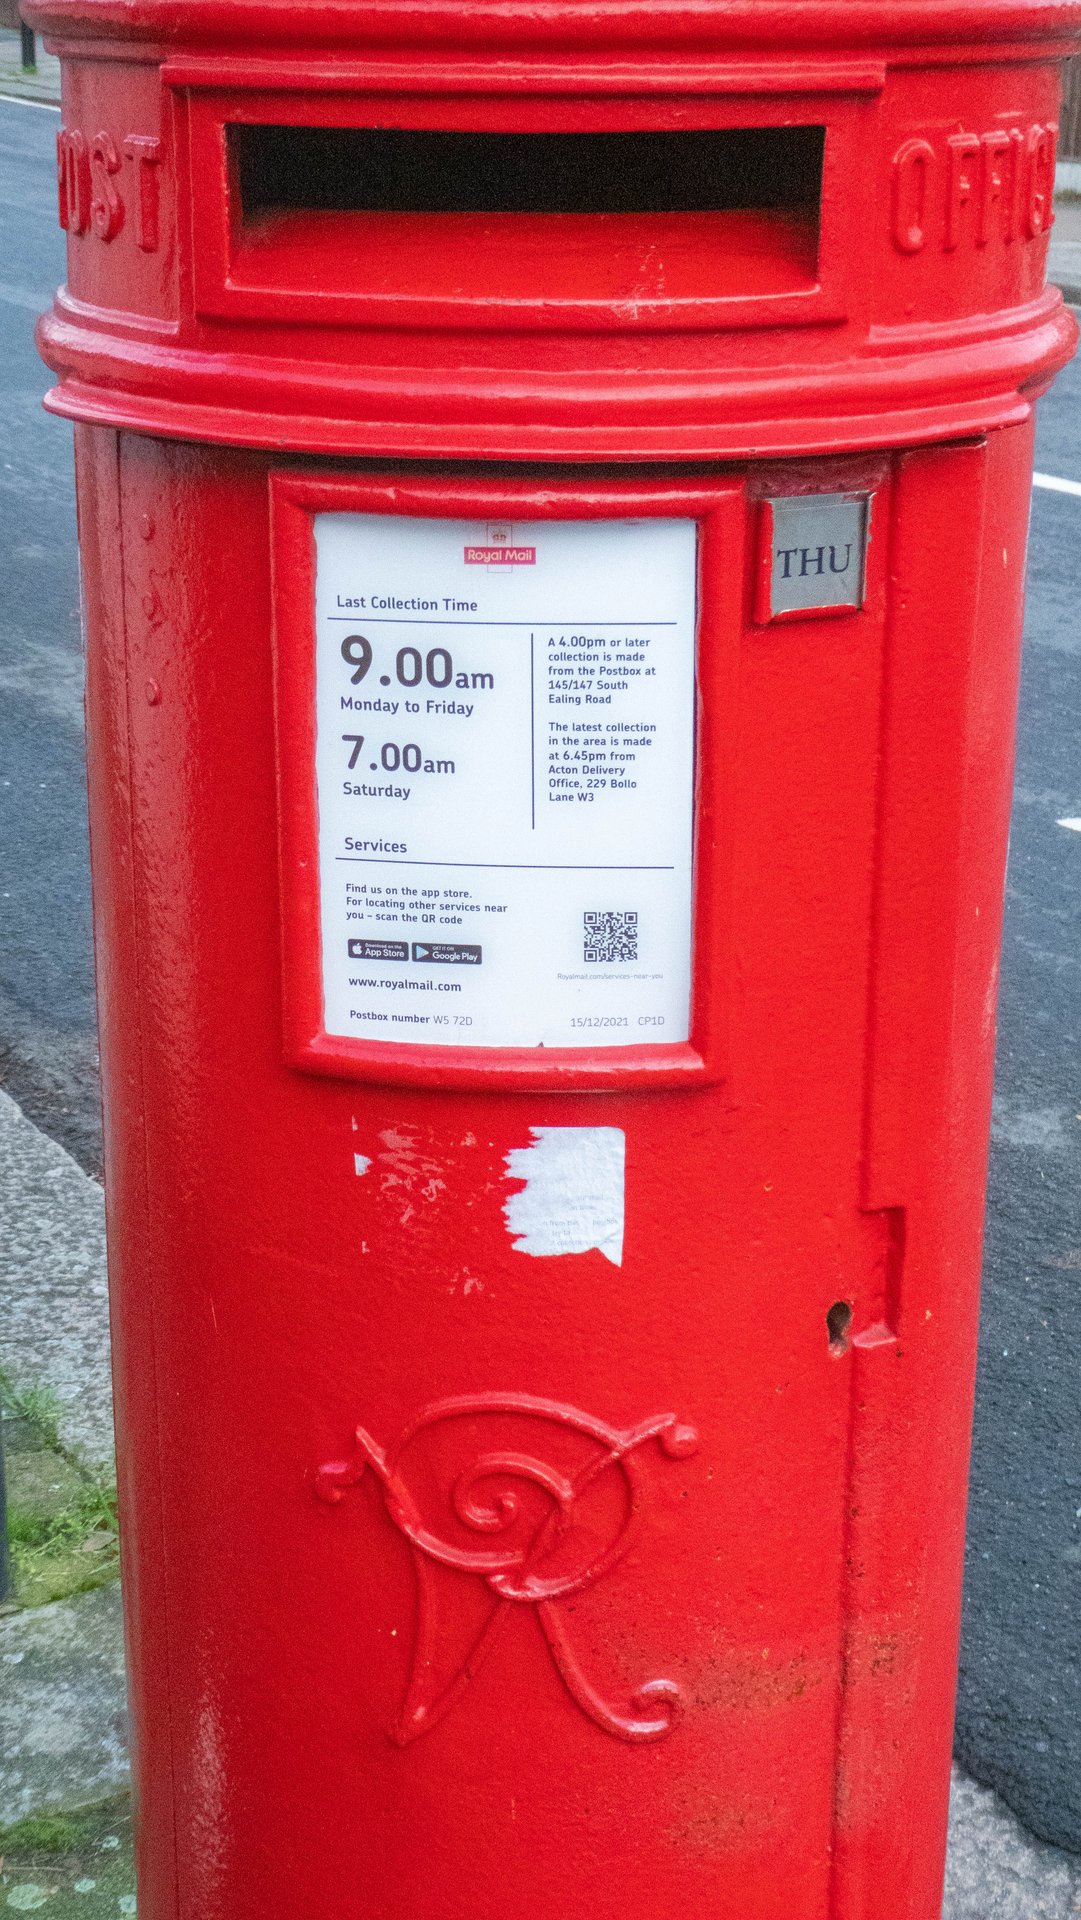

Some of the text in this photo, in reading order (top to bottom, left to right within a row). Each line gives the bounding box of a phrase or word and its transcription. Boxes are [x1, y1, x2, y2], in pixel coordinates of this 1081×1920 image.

[467, 549, 533, 563] Royal Mail
[776, 543, 853, 579] THU
[336, 594, 478, 612] Last Collection Time
[547, 635, 651, 650] A 4.00pm or later
[340, 634, 495, 690] 9.00am
[547, 651, 646, 662] collection is made
[547, 665, 657, 676] from the Postbox at
[548, 679, 629, 691] 145/147 South
[548, 693, 612, 706] Ealing Road
[340, 695, 474, 718] Monday to Friday
[548, 721, 657, 733] The latest collection
[548, 735, 653, 747] in the area is made
[341, 734, 456, 775] 7.00am
[548, 750, 636, 763] at 6.45pm from
[548, 764, 626, 777] Acton Delivery
[548, 777, 637, 790] Office, 229 Bollo
[342, 781, 411, 801] Saturday
[548, 791, 595, 802] Lane W3
[344, 836, 408, 854] Services
[345, 882, 473, 900] Find us on the app store.
[346, 896, 508, 913] For locating other services near
[345, 911, 365, 921] you
[375, 913, 399, 922] scan
[401, 912, 419, 923] the
[421, 913, 436, 924] QR
[439, 915, 463, 925] code
[364, 948, 405, 958] App Store
[432, 950, 478, 963] Google Play
[557, 972, 664, 981] Royalmail.com/services-near-you
[348, 977, 462, 992] www.royalmail.com
[349, 1009, 473, 1026] Postbox number W5 72D
[570, 1015, 665, 1028] 15/12/2021 CP1D
